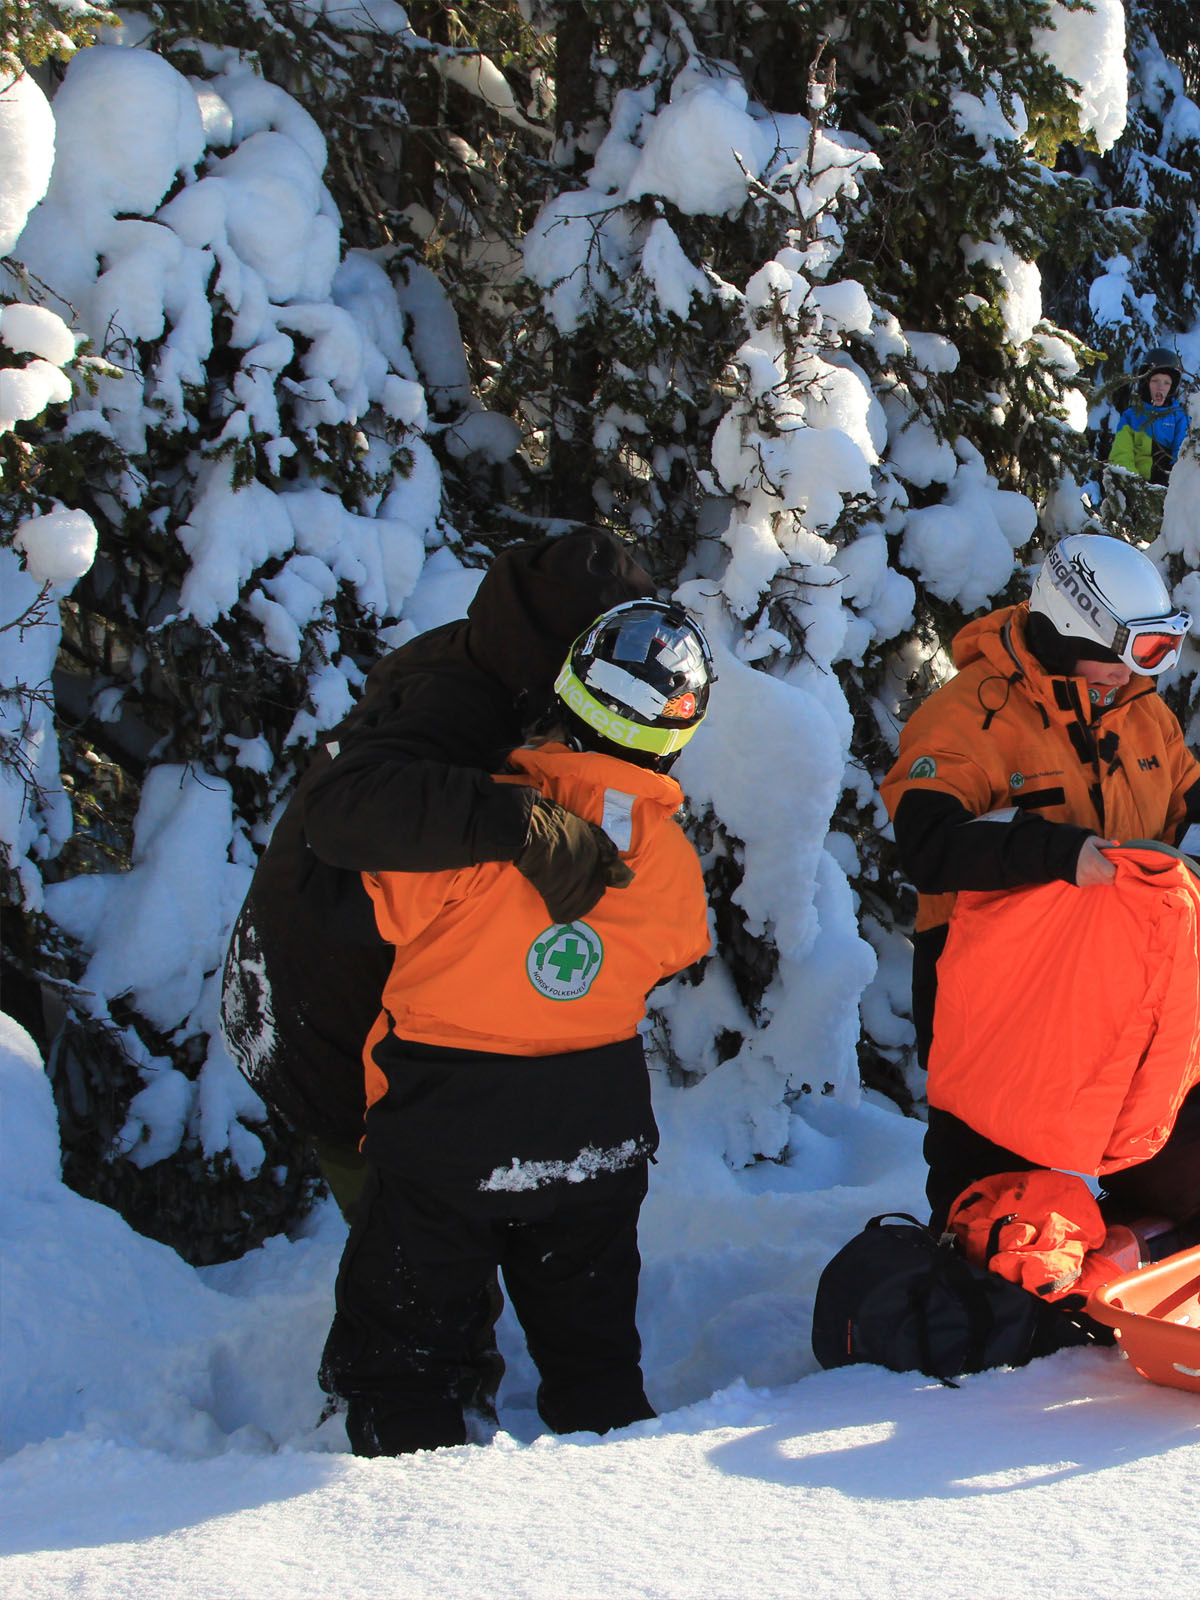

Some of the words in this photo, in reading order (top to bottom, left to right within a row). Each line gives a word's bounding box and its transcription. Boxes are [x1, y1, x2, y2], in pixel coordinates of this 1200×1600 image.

[560, 682, 641, 746] verest
[1137, 754, 1160, 771] HH
[533, 971, 549, 991] NORSK
